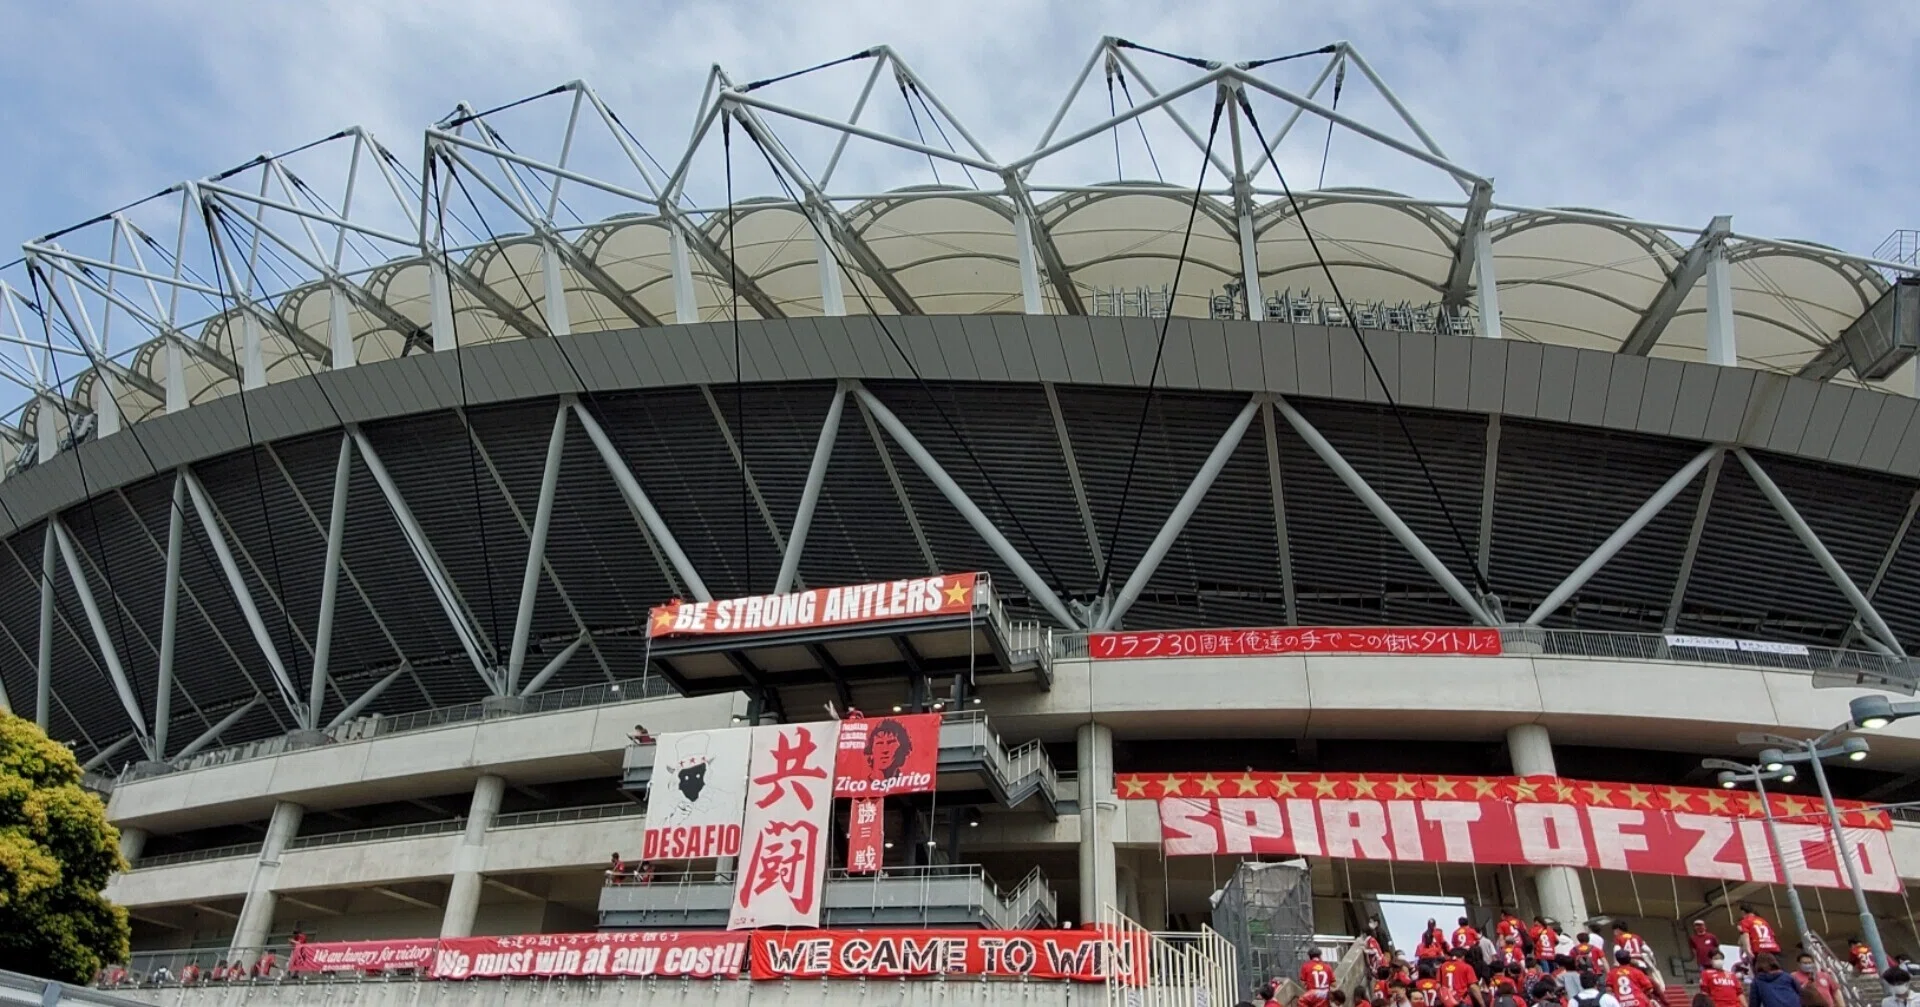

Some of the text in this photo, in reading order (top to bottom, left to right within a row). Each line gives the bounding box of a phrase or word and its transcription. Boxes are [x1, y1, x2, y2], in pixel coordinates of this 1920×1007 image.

[673, 576, 944, 631] BE STRONG ANTLERS
[835, 771, 931, 793] Zico espirito
[644, 823, 741, 858] DESAFIO
[1158, 796, 1900, 893] SPIRIT OF ZICO
[1458, 933, 1467, 947] 9
[1540, 934, 1550, 947] 8
[1753, 924, 1771, 940] 12
[313, 949, 327, 963] We
[342, 947, 376, 965] hungry
[377, 946, 396, 965] for
[396, 945, 432, 962] victory
[1623, 937, 1642, 955] 41
[435, 942, 746, 977] We must win at any cost!!
[766, 937, 1133, 976] WE CAME TO WIN
[1311, 970, 1330, 988] 12
[1445, 972, 1455, 992] 1
[1617, 975, 1632, 996] 8
